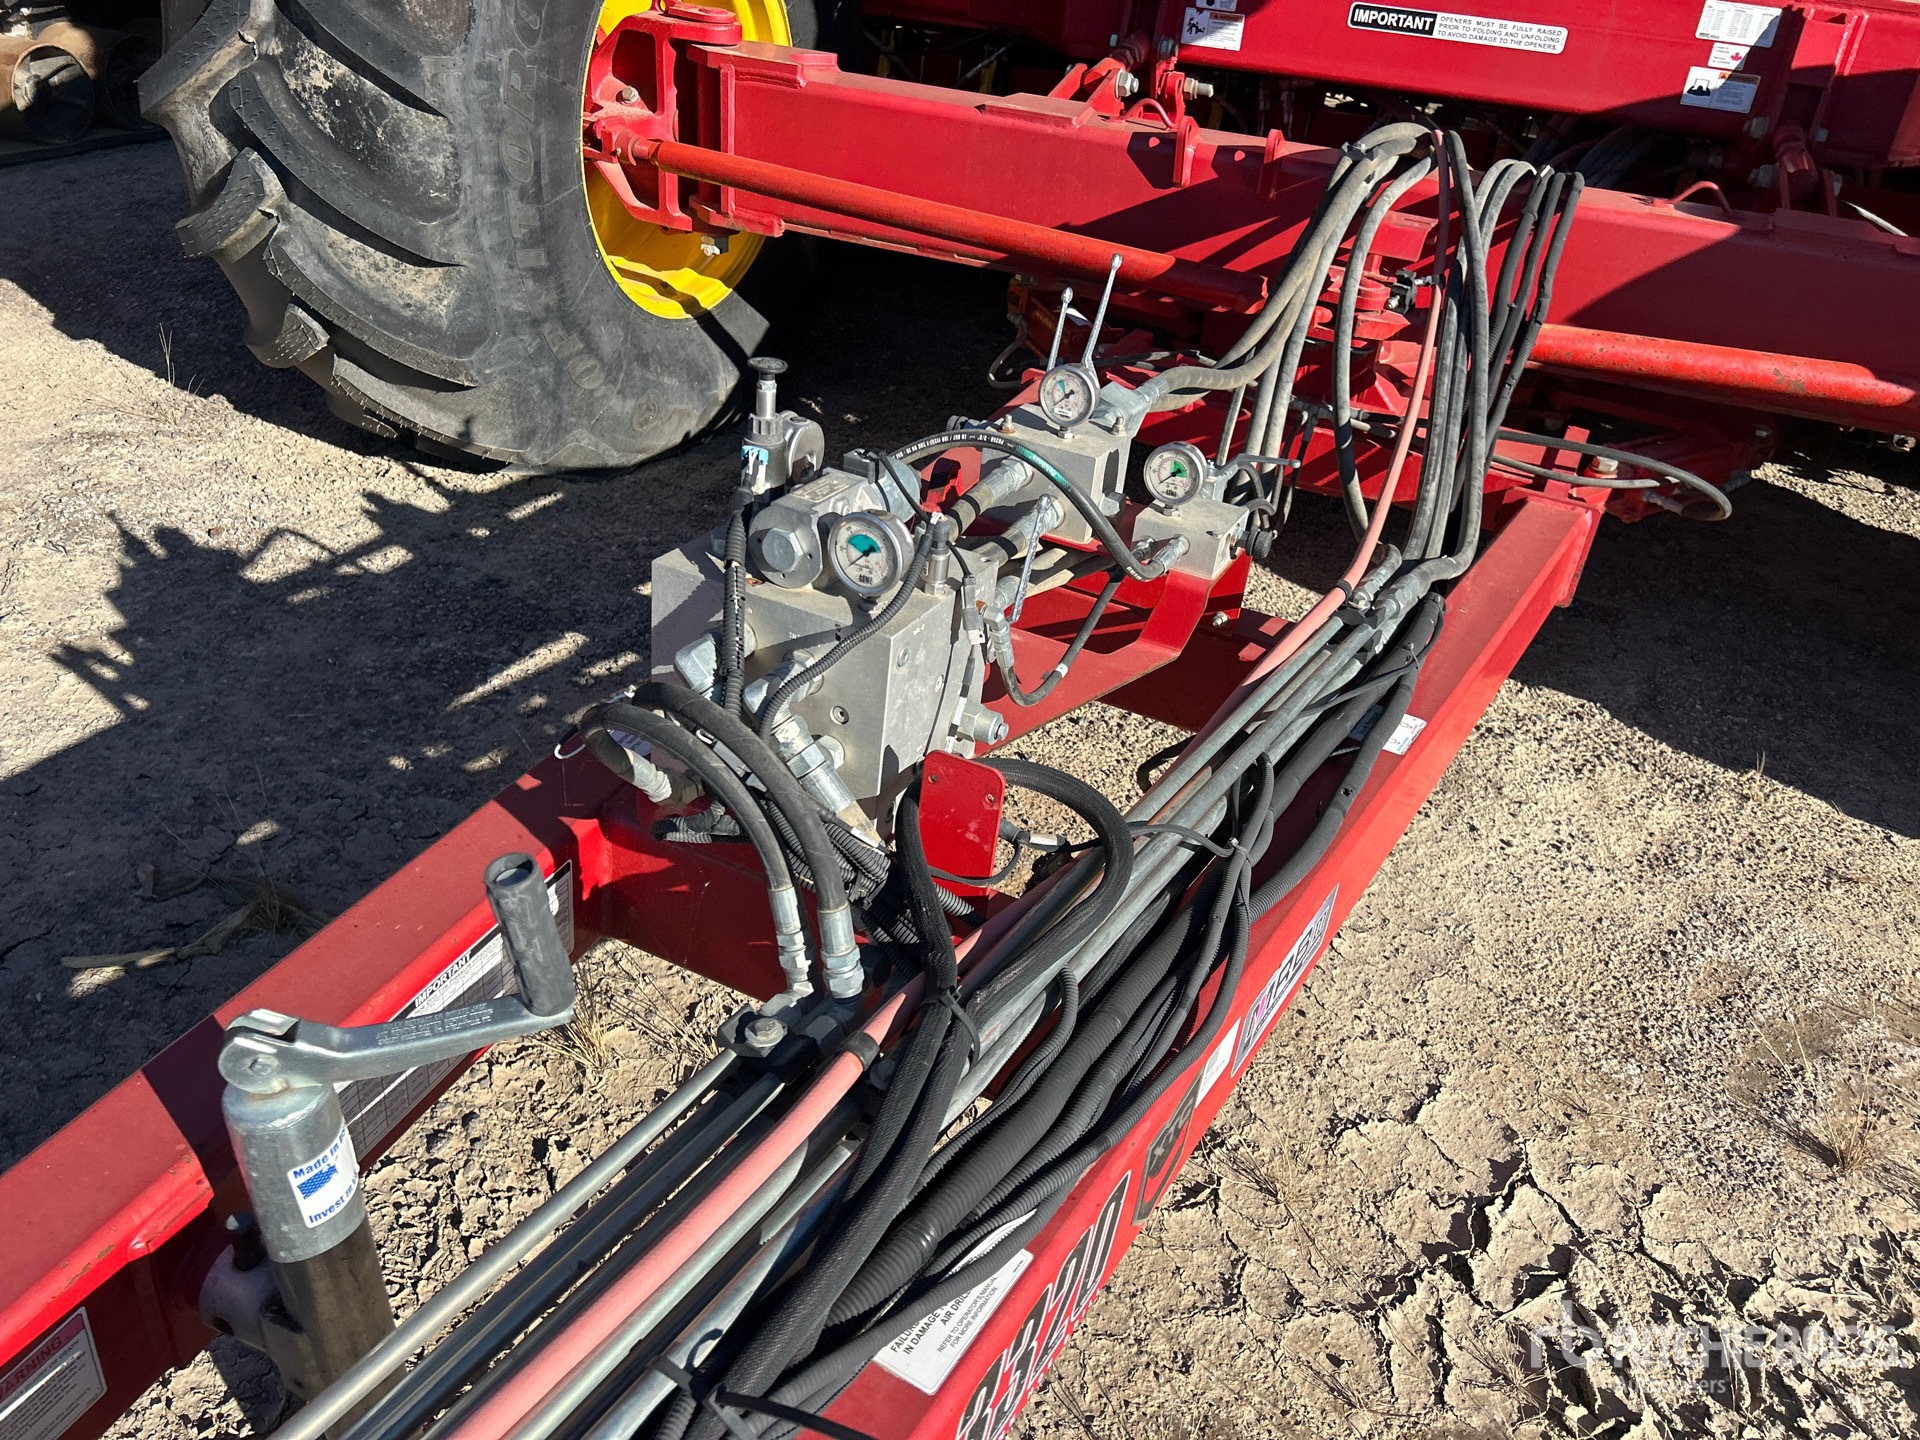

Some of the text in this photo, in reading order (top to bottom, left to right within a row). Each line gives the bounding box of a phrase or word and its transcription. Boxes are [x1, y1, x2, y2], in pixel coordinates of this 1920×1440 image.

[1353, 8, 1434, 31] IMPORTANT
[1439, 23, 1459, 31] PRIOR
[1473, 27, 1502, 35] FOLDING
[1521, 33, 1560, 43] UNFOLDING
[1440, 16, 1472, 25] OPENERS
[1476, 20, 1494, 28] MUST
[1512, 24, 1533, 32] FULLY
[1537, 28, 1562, 36] RAISED
[1447, 31, 1467, 39] AVOID
[1469, 33, 1497, 43] DAMAGE
[413, 951, 472, 1008] IMPORTANT
[293, 1143, 340, 1179] Made in
[309, 1196, 345, 1223] Invest
[937, 1334, 951, 1353] REFER
[950, 1325, 959, 1336] TO
[980, 1276, 998, 1299] MANUAL
[940, 1310, 954, 1326] AIR
[951, 1287, 998, 1348] FOR MORE INFORMATION
[891, 1322, 920, 1353] FAILUR
[902, 1312, 940, 1355] IN DAMAGE
